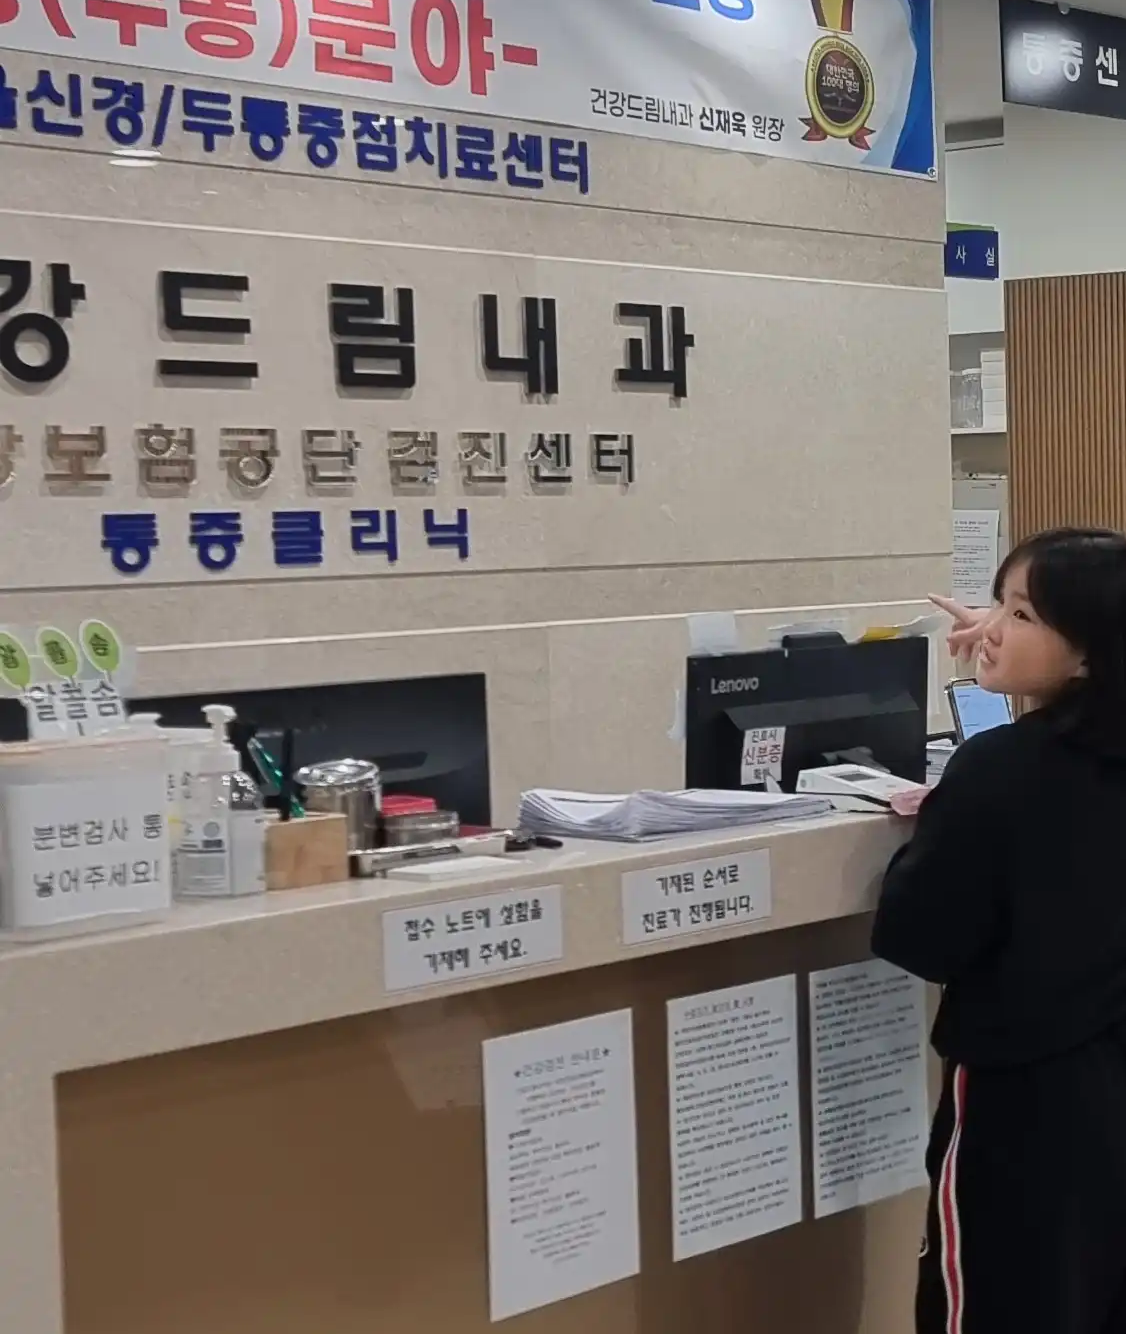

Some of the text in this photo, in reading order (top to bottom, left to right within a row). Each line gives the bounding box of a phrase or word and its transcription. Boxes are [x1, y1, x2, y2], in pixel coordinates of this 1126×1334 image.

[590, 88, 785, 142] 건강드림내과 신재욱 원장
[101, 508, 470, 573] 통증클리닉
[710, 677, 759, 695] Lenovo
[32, 816, 128, 851] 분변검사
[656, 864, 739, 896] 기재된 순서로
[404, 899, 544, 942] 접수 노트에 성함을
[642, 895, 754, 933] 진료가 진행됩니다.
[423, 938, 528, 974] 기재해 주세요.
